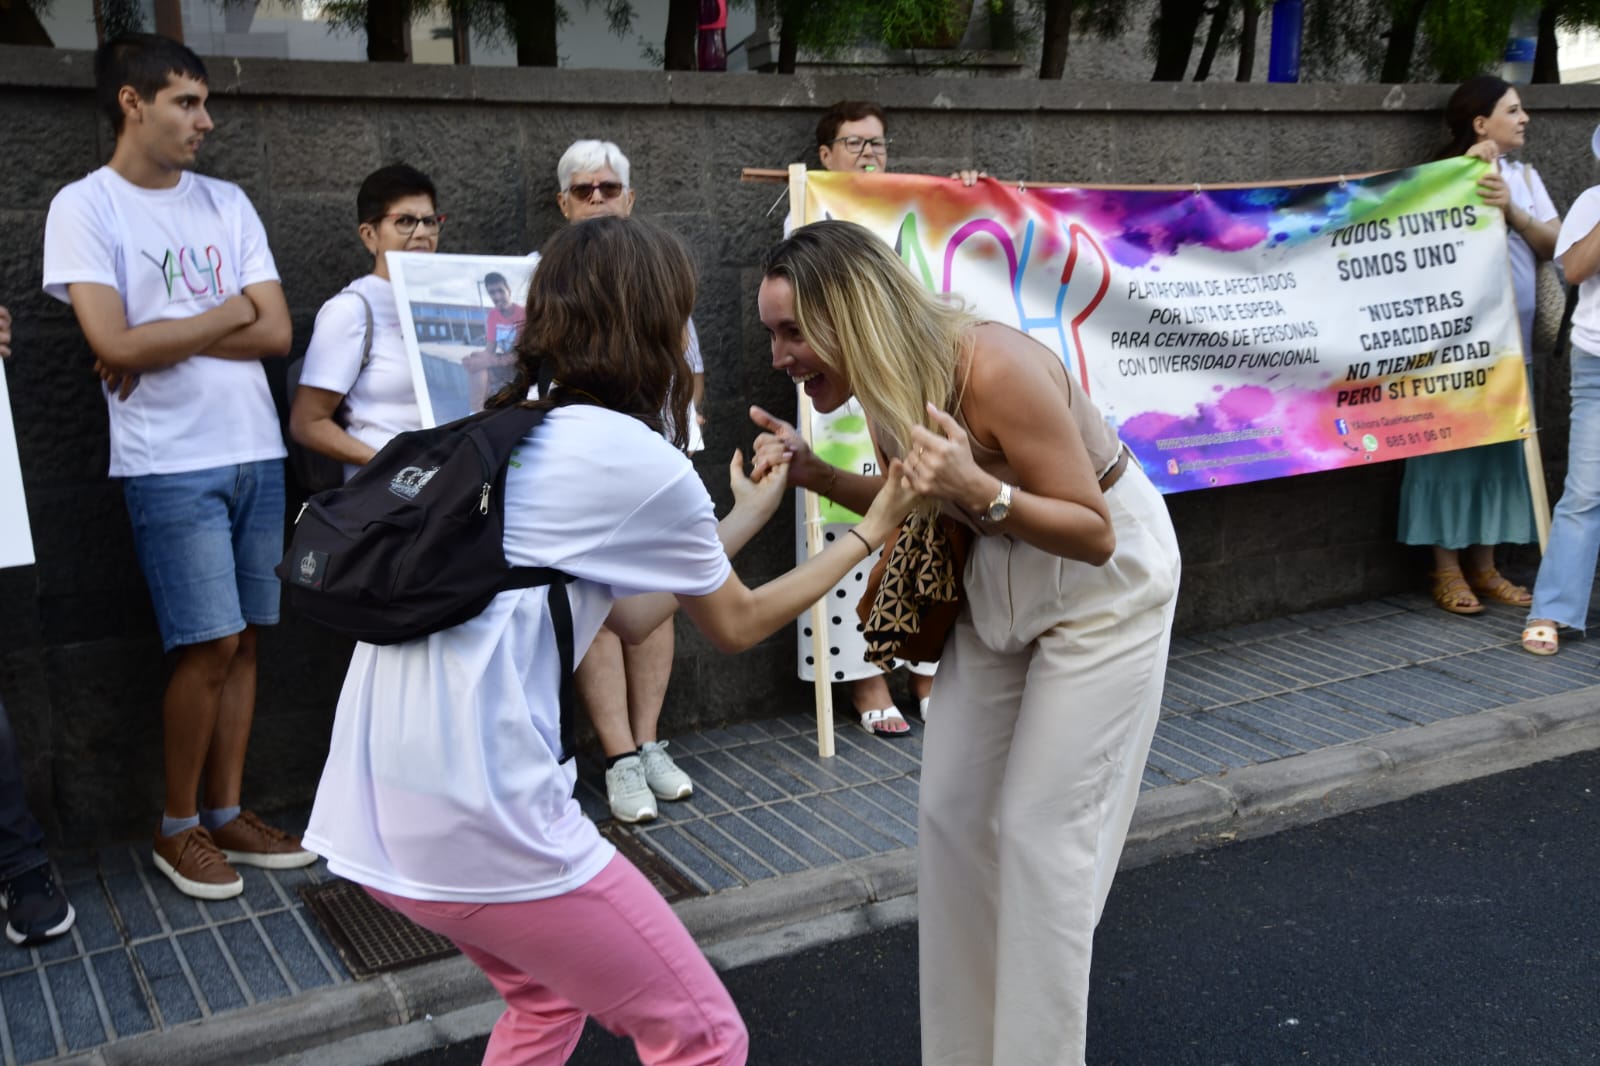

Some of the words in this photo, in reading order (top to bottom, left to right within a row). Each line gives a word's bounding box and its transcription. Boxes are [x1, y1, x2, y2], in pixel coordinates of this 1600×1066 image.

[1398, 205, 1477, 237] JUNTOS
[1337, 250, 1407, 281] SOMOS
[1414, 240, 1464, 269] UNO"
[1128, 280, 1203, 299] PLATAFORMA
[1204, 280, 1224, 296] DE
[1225, 272, 1297, 295] AFECTADOS
[1148, 308, 1182, 325] POR
[1185, 305, 1217, 324] LISTA
[1217, 304, 1236, 321] DE
[1237, 300, 1285, 320] ESPERA
[1111, 331, 1149, 350] PARA
[1154, 330, 1229, 348] CENTROS
[1231, 329, 1250, 347] DE
[1252, 320, 1318, 345] PERSONAS
[1359, 316, 1473, 351] CAPACIDADES
[1118, 357, 1147, 377] CON
[1149, 354, 1237, 375] DIVERSIDAD
[1238, 347, 1320, 369] FUNCIONAL
[1346, 361, 1371, 382] NO
[1377, 349, 1439, 376] TIENEN
[1441, 340, 1490, 364] EDAD
[1336, 385, 1382, 407] PERO
[1411, 366, 1495, 397] FUTURO"
